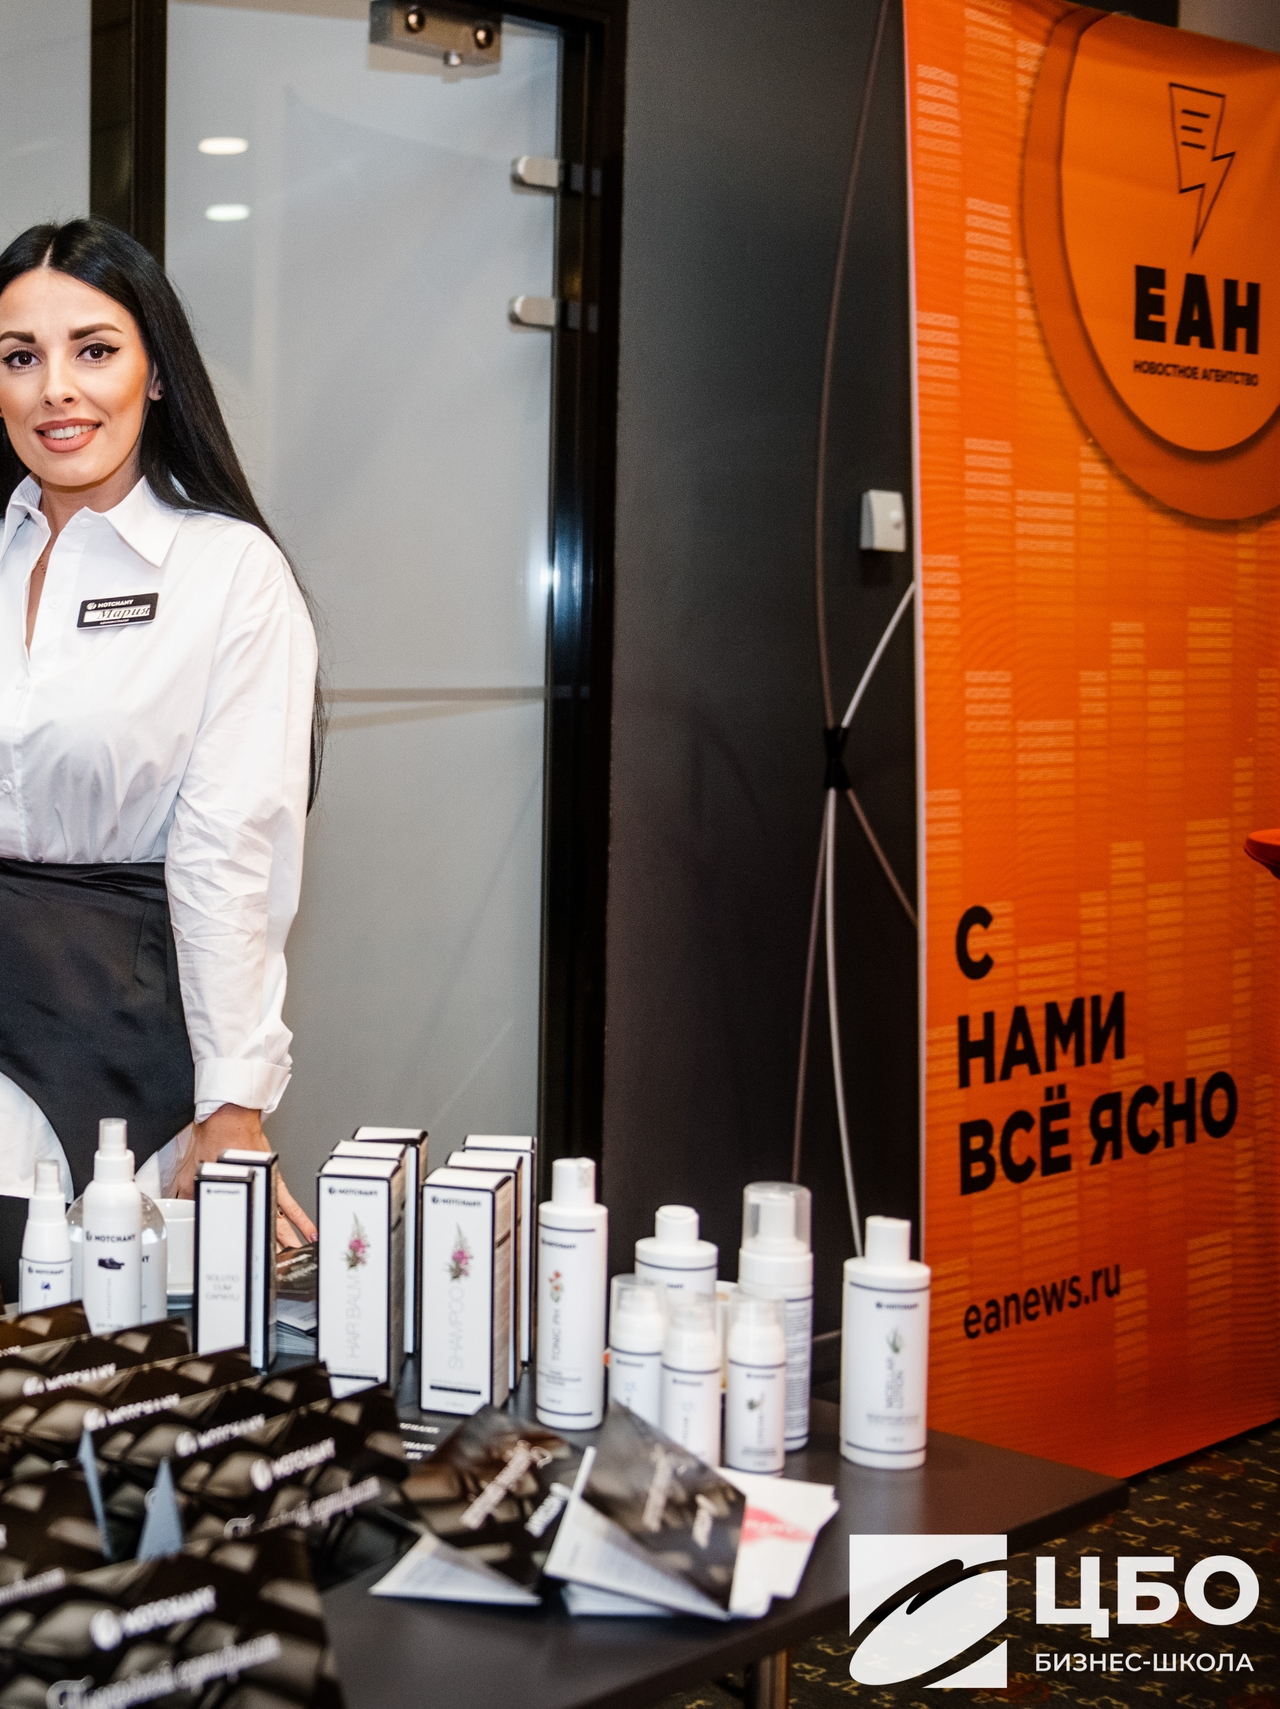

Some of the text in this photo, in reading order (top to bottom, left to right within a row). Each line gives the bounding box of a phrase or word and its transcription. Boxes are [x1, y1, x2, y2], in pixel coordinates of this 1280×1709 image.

[1134, 264, 1260, 354] ЕАН
[1133, 360, 1259, 387] НОВОСТНОЕ АГЕНТСТВО
[955, 906, 994, 981] С
[958, 991, 1126, 1089] НАМИ
[959, 1071, 1238, 1196] ВСЁ ЯСНО
[963, 1263, 1121, 1339] eanews.ru
